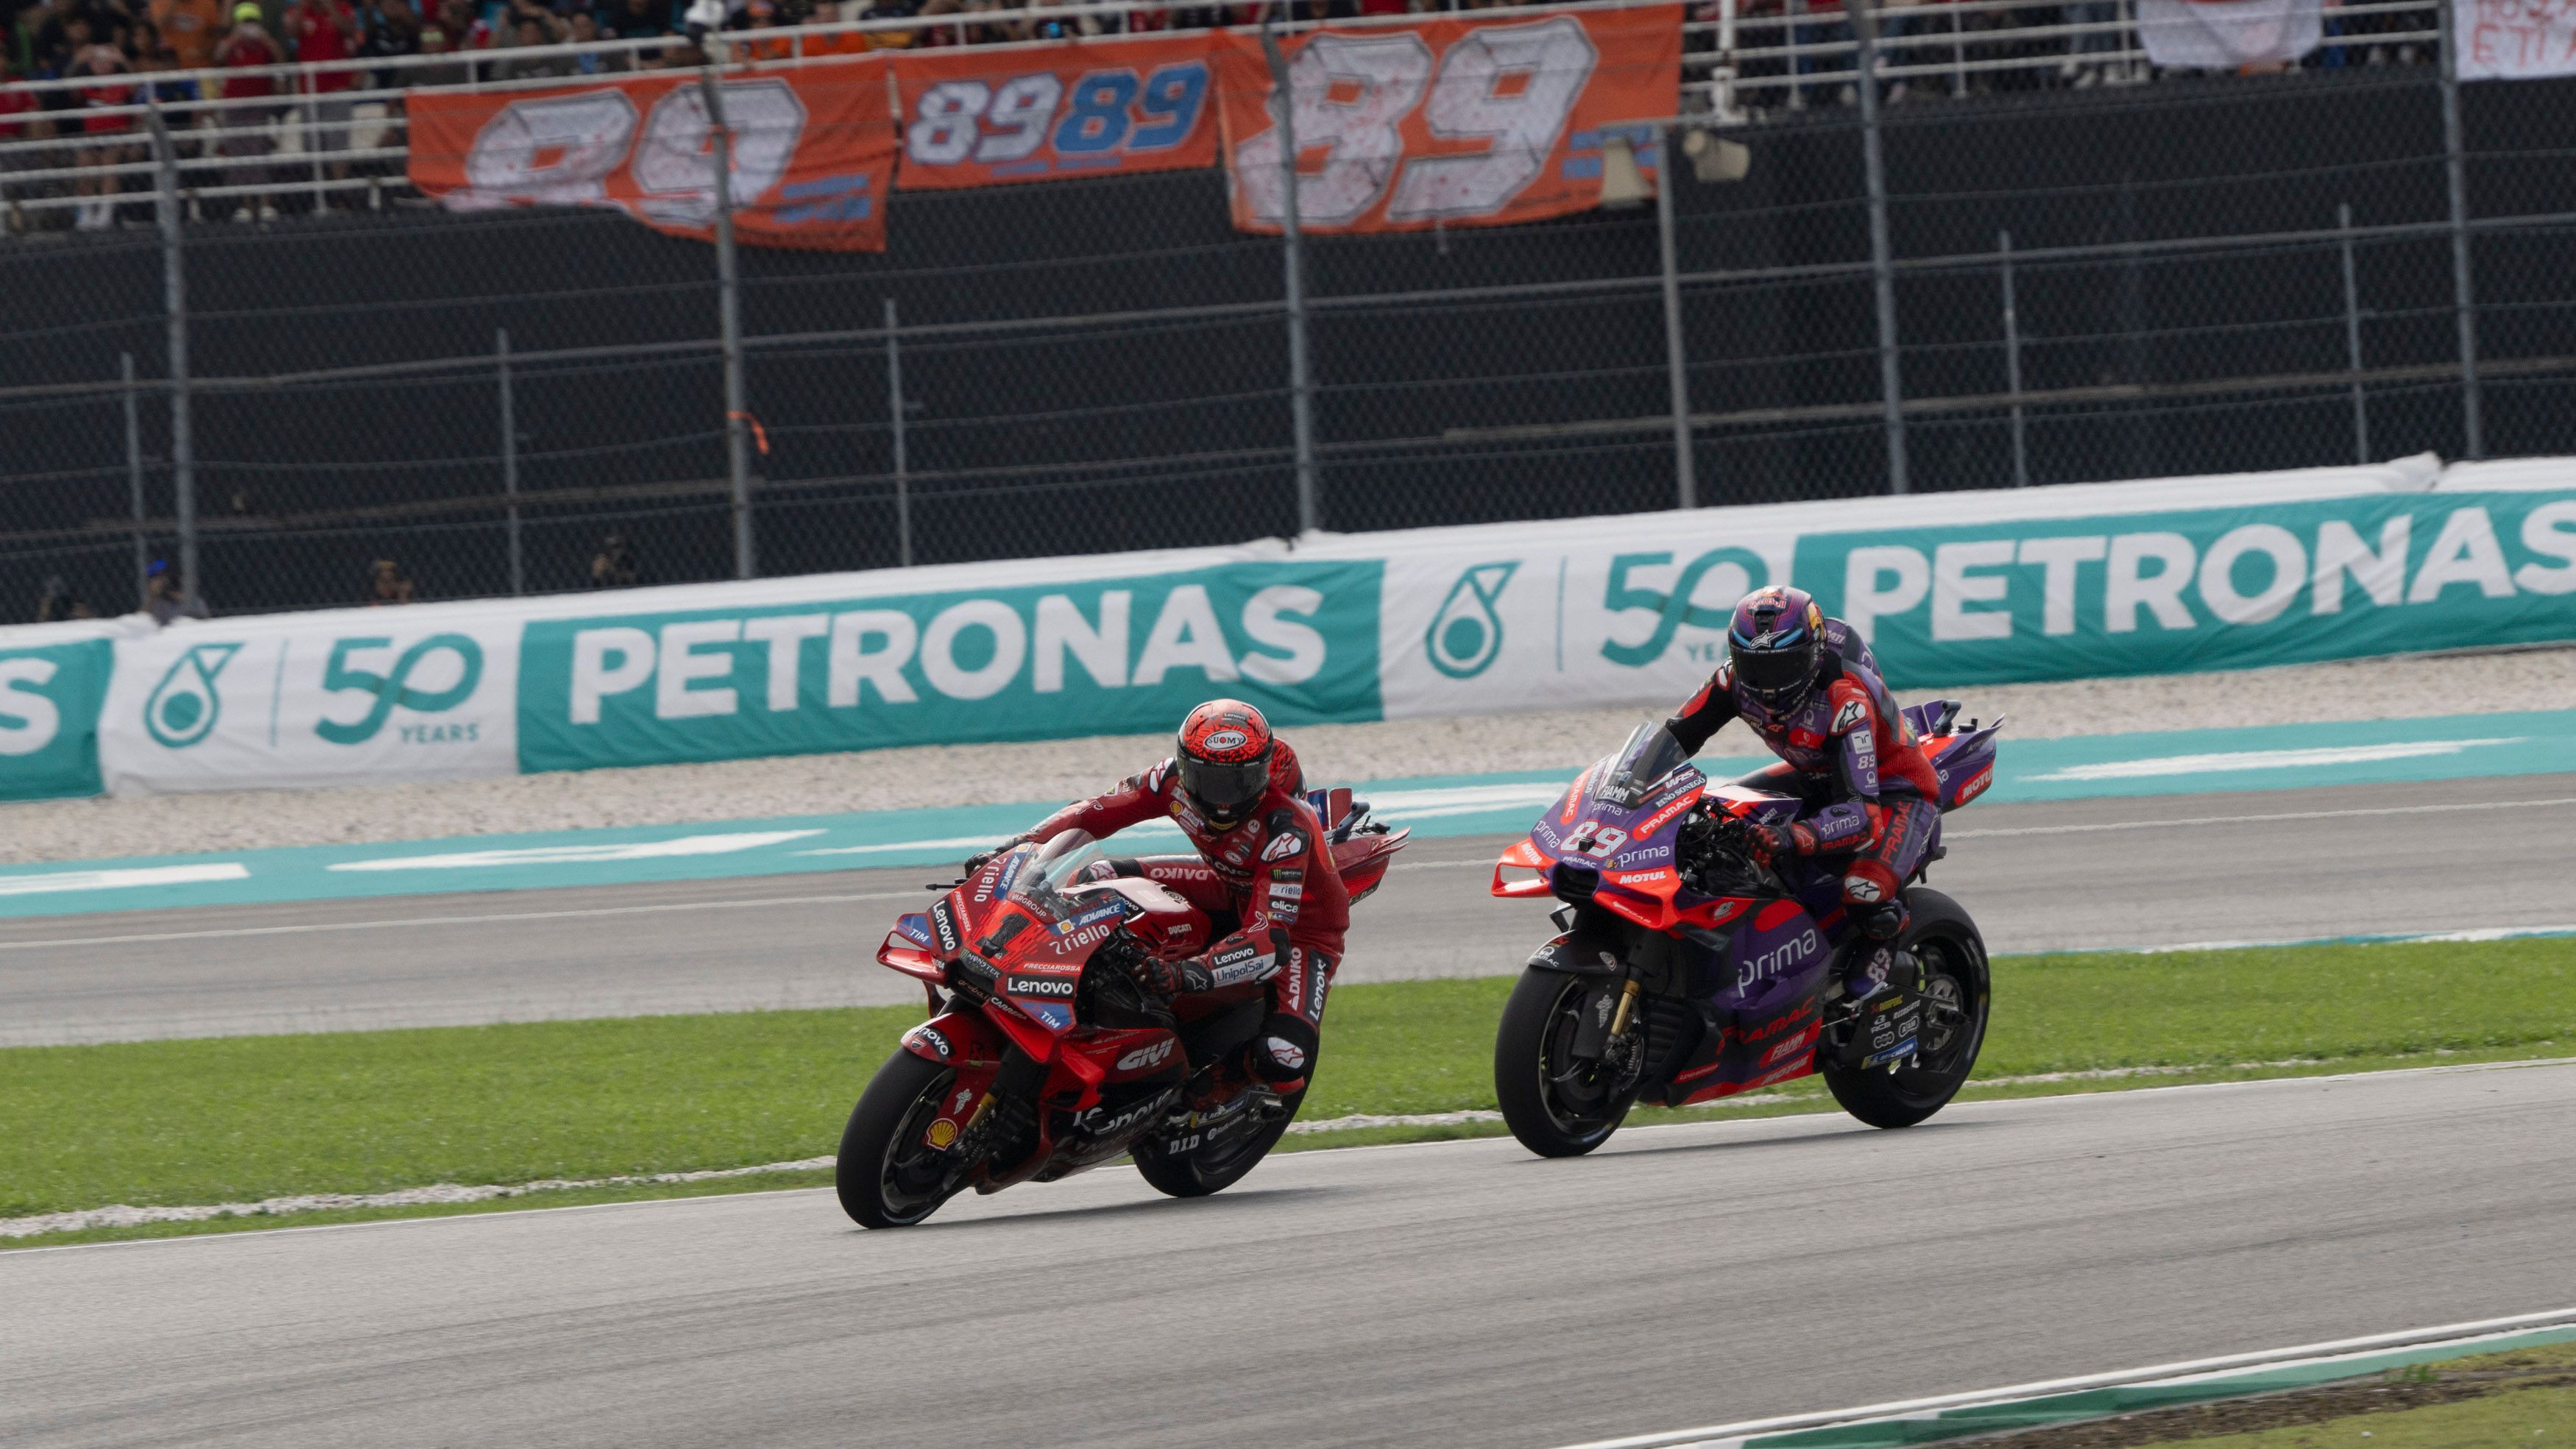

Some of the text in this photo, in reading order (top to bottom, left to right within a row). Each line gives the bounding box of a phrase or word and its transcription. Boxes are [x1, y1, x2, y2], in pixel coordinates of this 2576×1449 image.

[1232, 15, 1601, 225] 89
[1844, 500, 2576, 644] PETRONAS
[1600, 546, 1771, 668] 50
[568, 584, 1326, 725] PETRONAS
[314, 633, 484, 745] 50
[400, 723, 481, 743] YEARS
[1208, 735, 1244, 745] SUOMY
[1857, 754, 1875, 770] 89
[1665, 769, 1695, 790] WRS
[1674, 776, 1706, 796] SONEGO
[1962, 771, 1992, 799] MOTU
[1590, 801, 1622, 816] prima
[1641, 796, 1694, 834] PRAMAC
[1535, 820, 1560, 849] prima
[1821, 815, 1860, 838] prima
[1560, 820, 1630, 858] 89
[1521, 843, 1543, 865] MOTUL
[1562, 856, 1597, 869] PRAMAC
[1617, 846, 1670, 868] prima
[974, 865, 999, 902] riello
[999, 855, 1020, 890] ADVANCE
[1619, 871, 1667, 884] MOTUL
[1281, 885, 1301, 896] riello
[1011, 893, 1047, 918] VARGROUP
[1079, 903, 1121, 926] ADVANCE
[1271, 900, 1298, 913] elica
[910, 928, 930, 943] TIM
[933, 899, 956, 951] Lenovo
[1167, 923, 1192, 935] DUCATI
[1064, 924, 1111, 952] riello
[1214, 946, 1254, 965] Lenovo
[1738, 928, 1817, 999] prima
[1023, 963, 1081, 972] FRECCIAROSSA
[1216, 959, 1264, 982] UnipolSai
[1007, 977, 1074, 995] Lenovo
[1309, 958, 1326, 1021] Lenov
[991, 996, 1027, 1021] CARRERA
[1040, 1010, 1061, 1030] TIM
[919, 1026, 949, 1056] novo
[1117, 1036, 1175, 1071] GIVI
